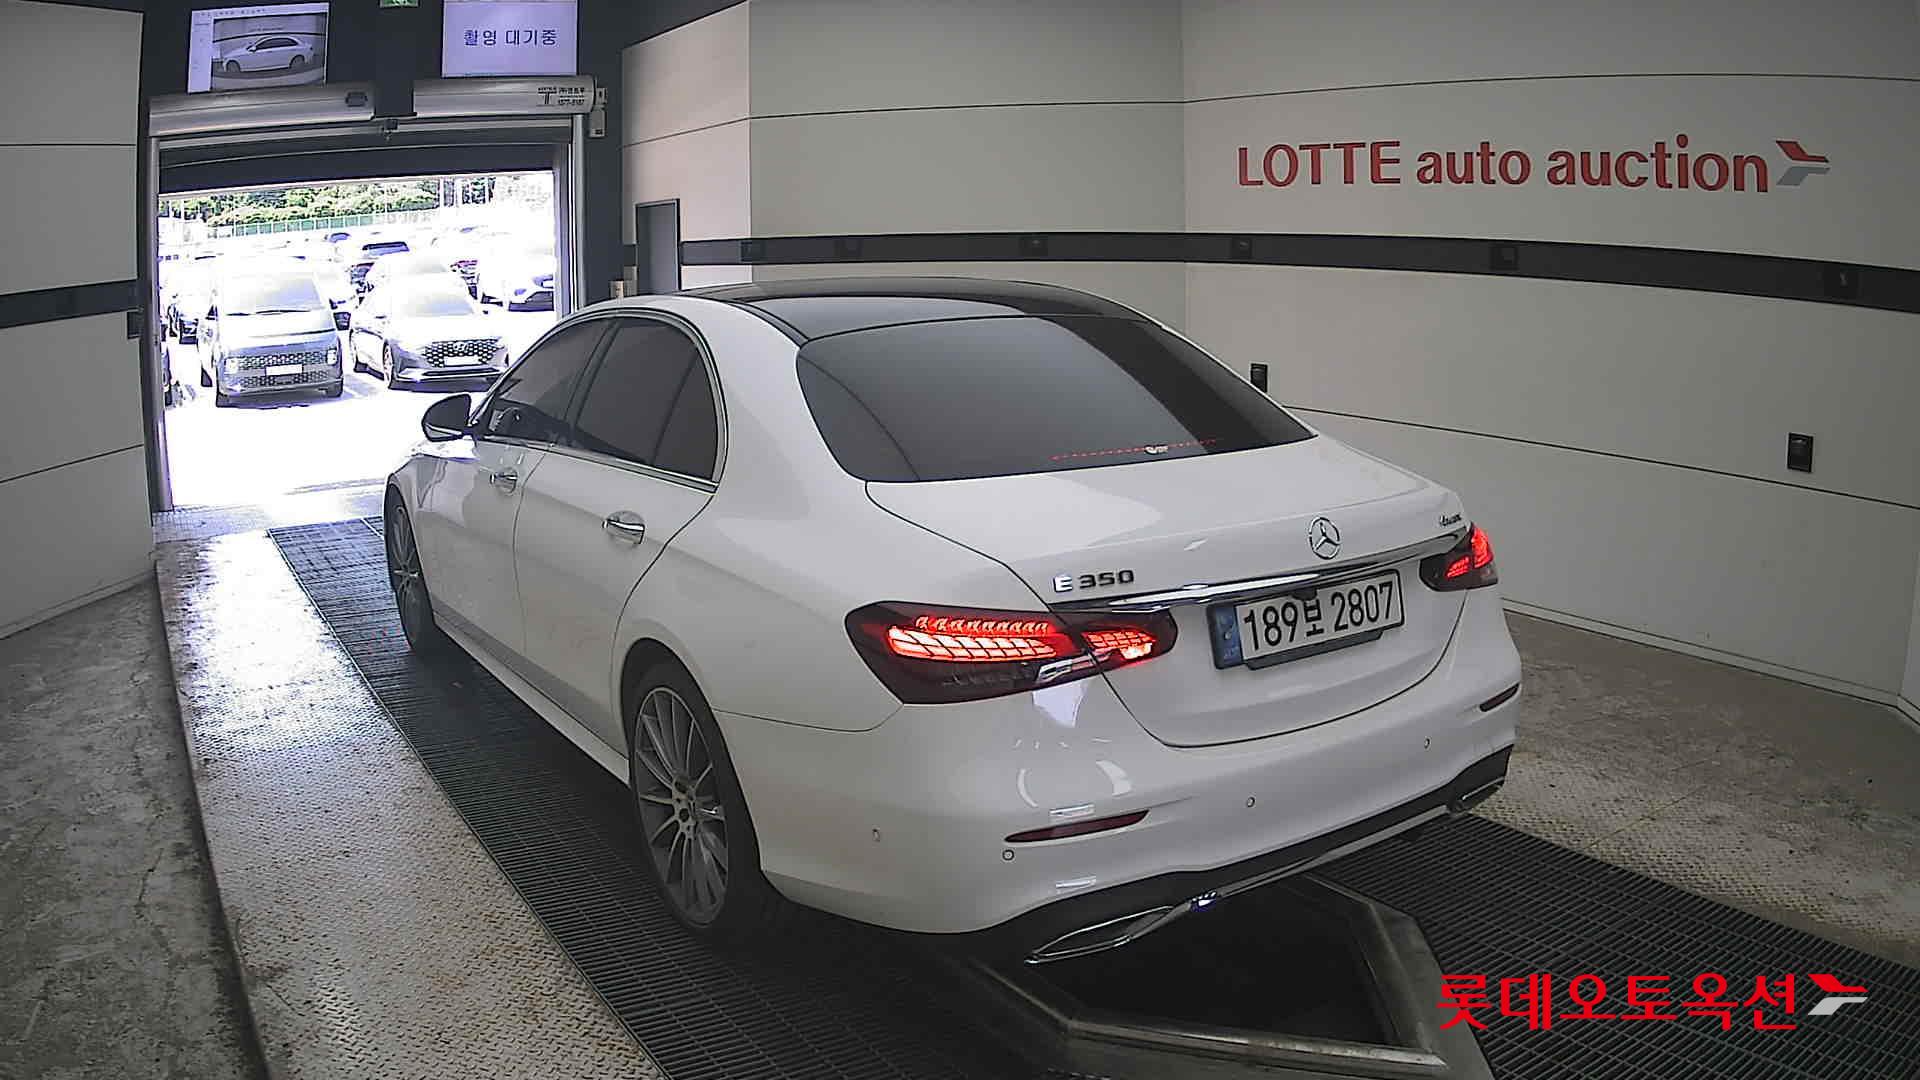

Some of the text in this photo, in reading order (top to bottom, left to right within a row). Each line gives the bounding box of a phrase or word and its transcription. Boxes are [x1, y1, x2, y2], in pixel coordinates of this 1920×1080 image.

[464, 29, 557, 46] 촬영 대기중
[1238, 134, 1769, 194] LOTTE auto auction
[1053, 569, 1134, 593] E 350
[1331, 580, 1394, 633] 2807
